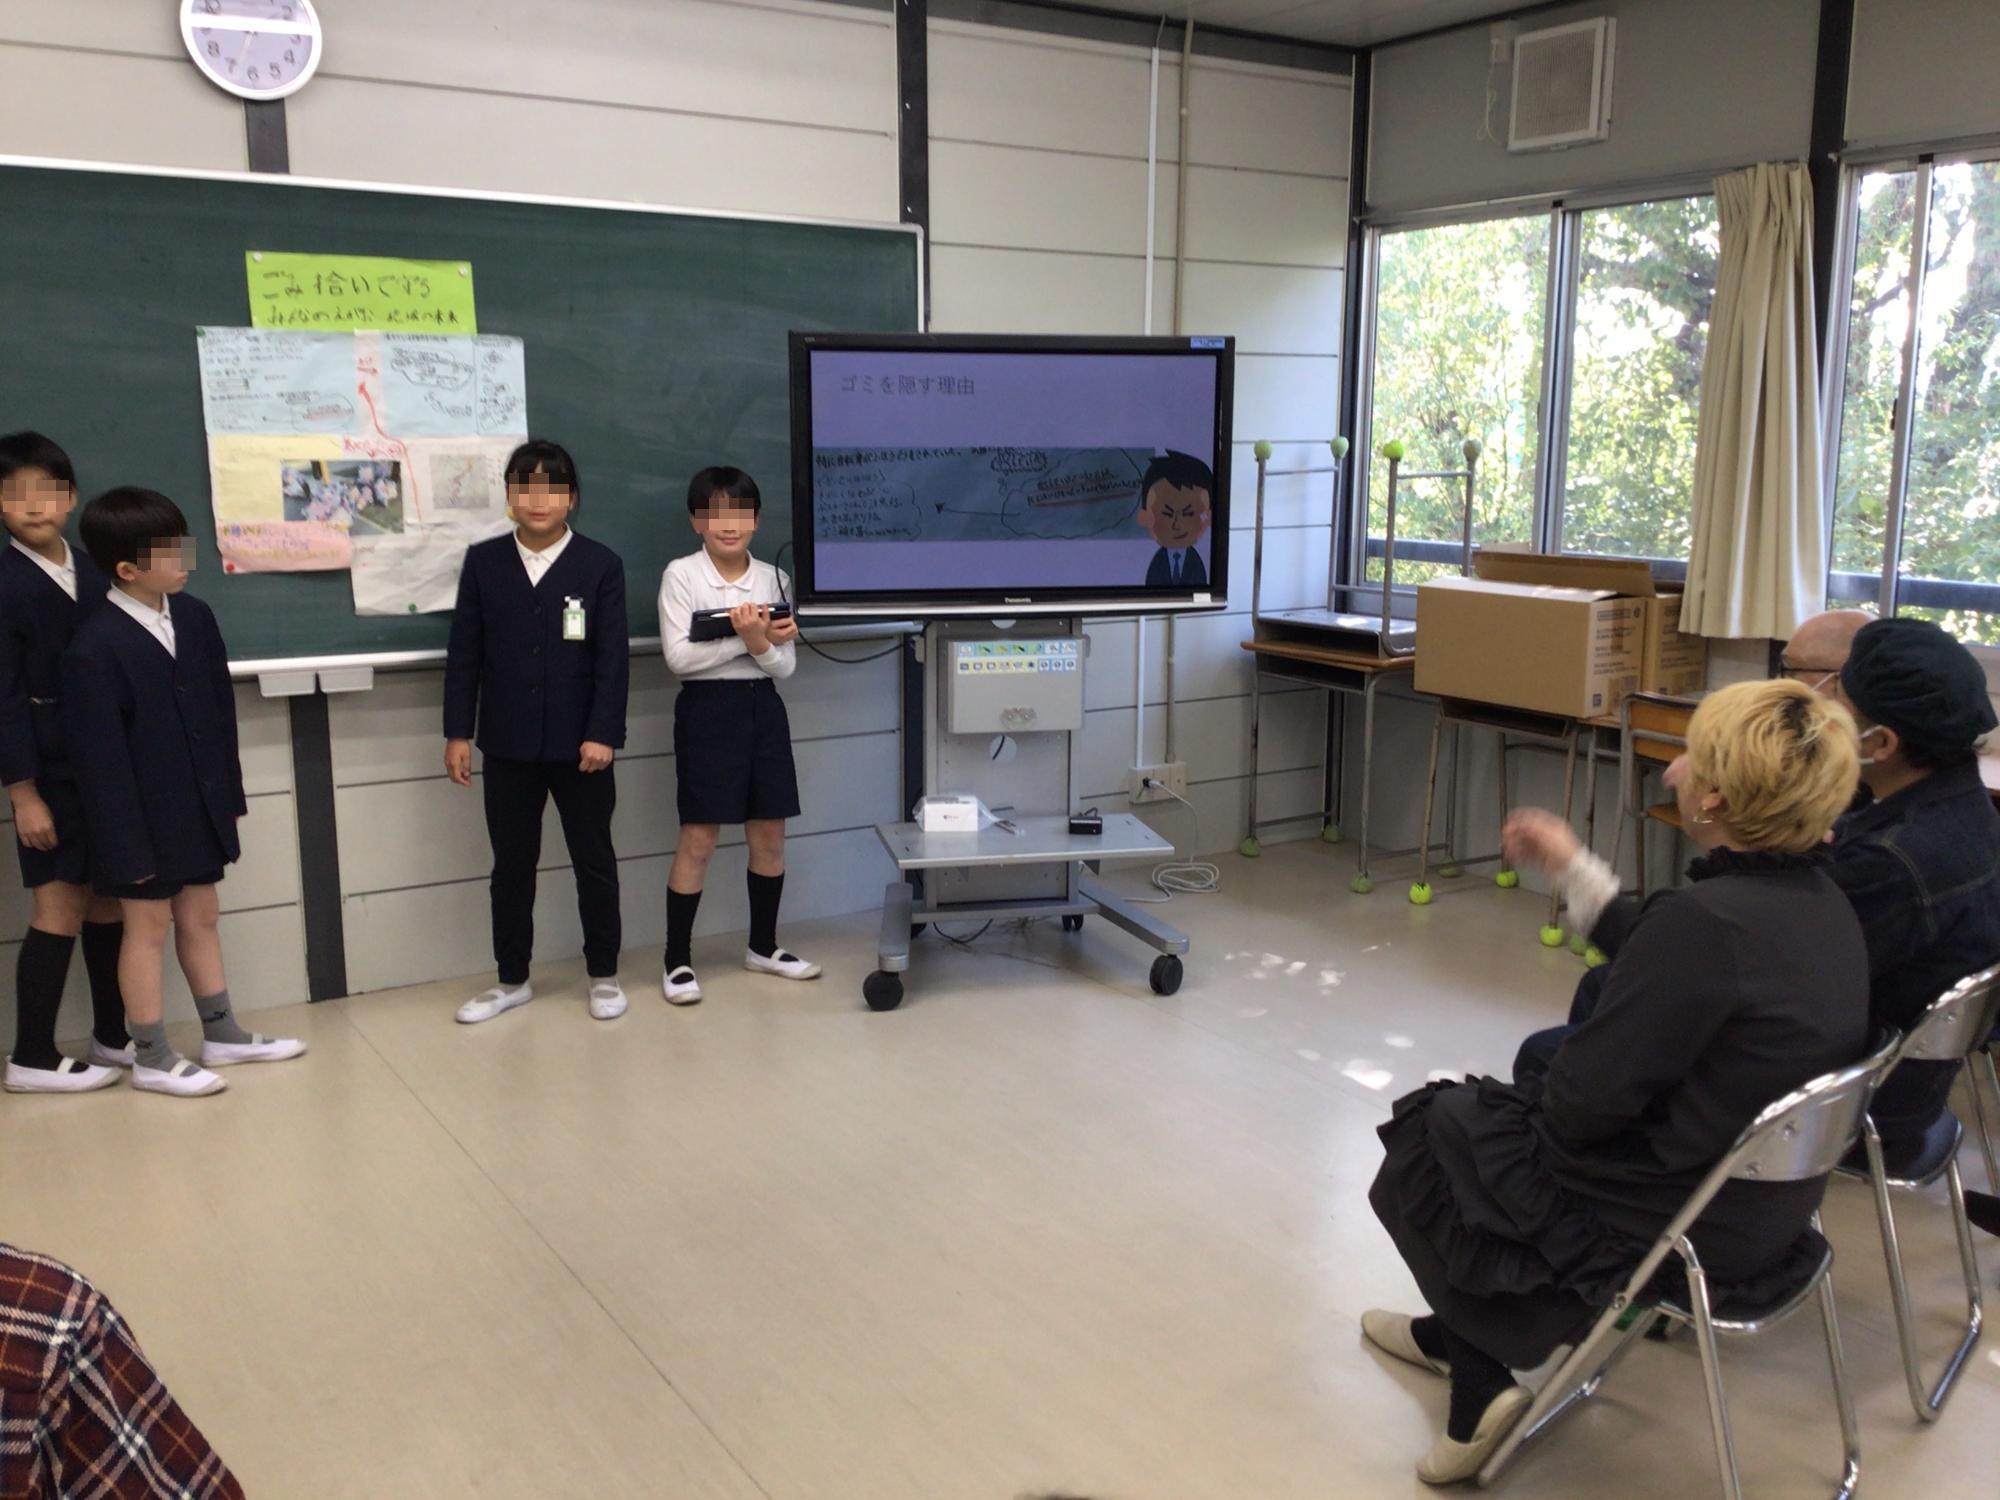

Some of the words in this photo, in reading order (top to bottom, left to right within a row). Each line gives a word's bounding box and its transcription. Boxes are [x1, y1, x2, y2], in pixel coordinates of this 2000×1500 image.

[841, 374, 976, 396] ゴミを隠す理由
